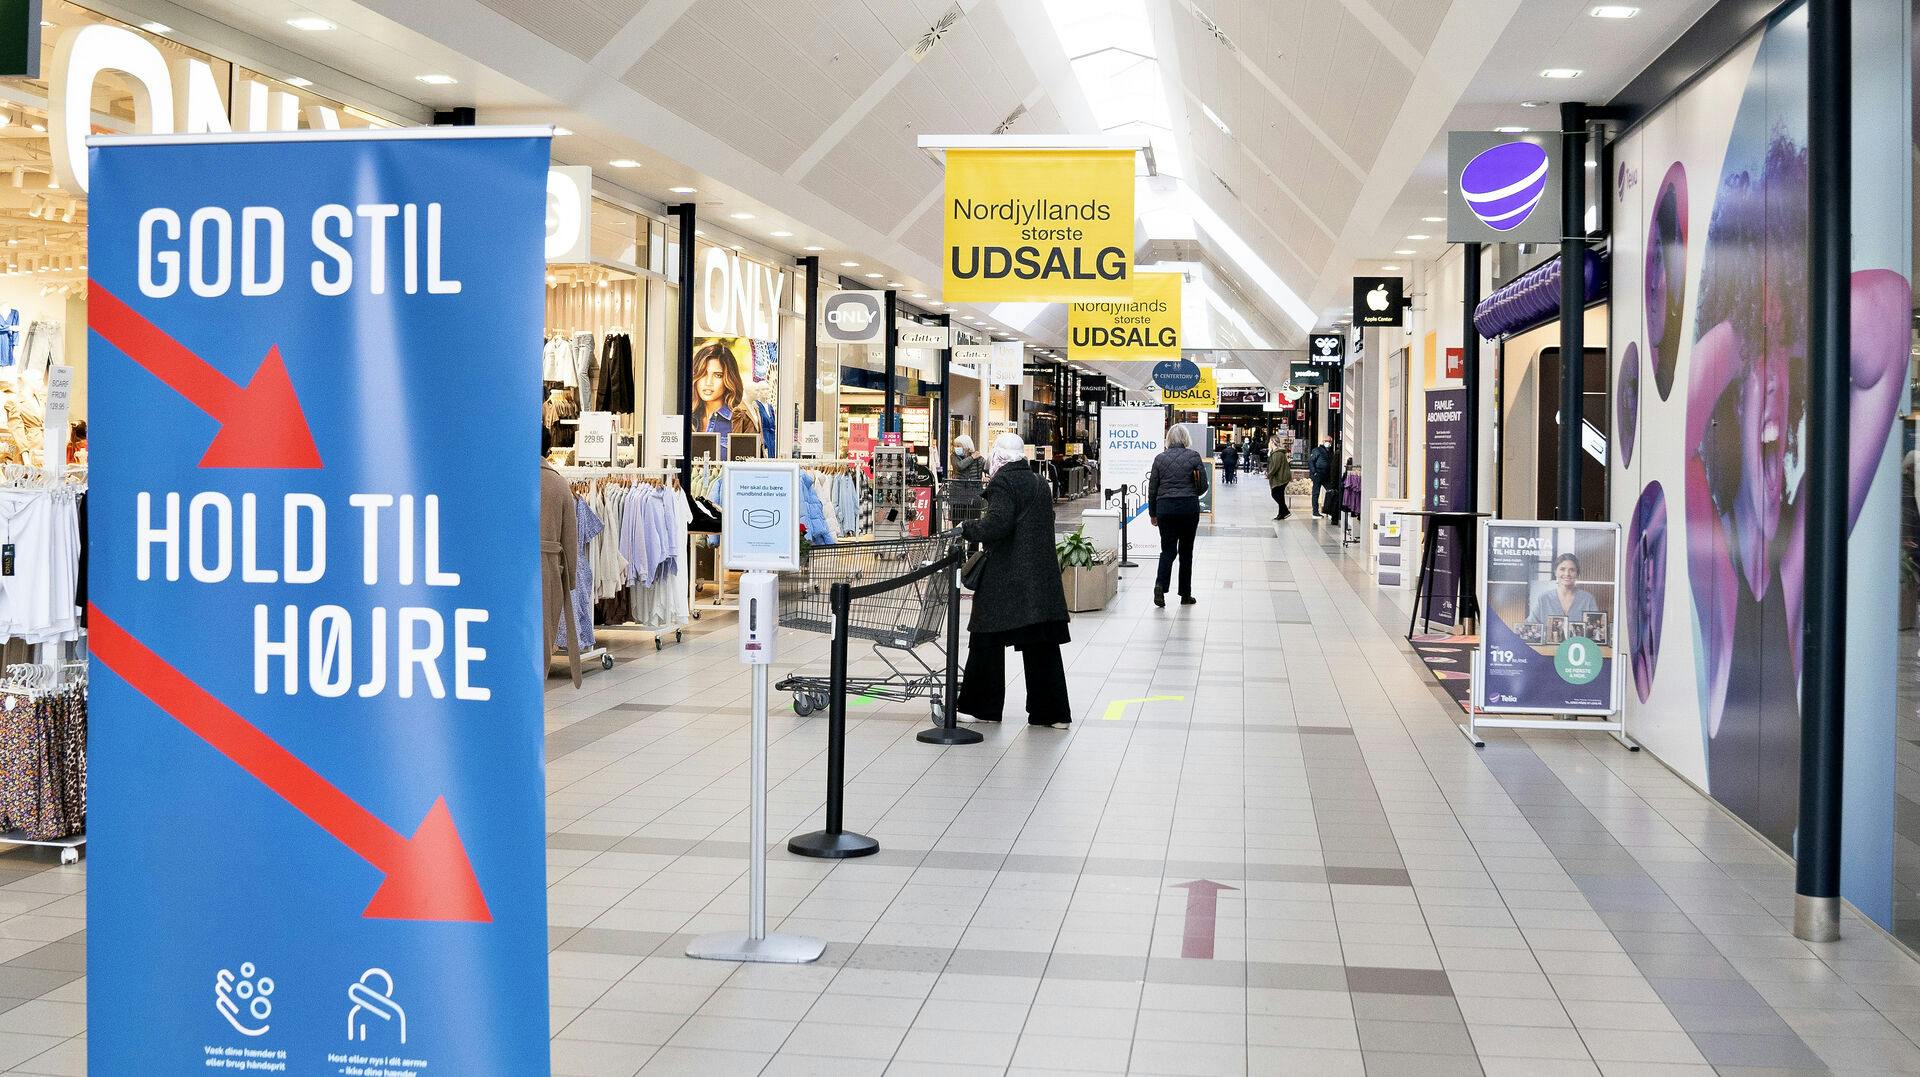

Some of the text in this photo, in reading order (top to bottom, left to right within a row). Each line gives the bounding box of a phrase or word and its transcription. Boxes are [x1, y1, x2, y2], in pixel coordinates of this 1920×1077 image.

[954, 198, 1111, 226] Nordjyllands
[1021, 226, 1083, 241] største
[138, 206, 285, 298] GOD
[311, 202, 462, 297] STIL
[951, 246, 1127, 281] UDSALG
[700, 247, 785, 340] ONLY
[827, 310, 878, 324] ONLY
[1114, 315, 1151, 325] største
[1073, 327, 1177, 348] UDSALG
[51, 391, 67, 399] FROM
[1163, 389, 1211, 399] UDSALG
[584, 435, 604, 443] 229.95
[660, 435, 679, 443] 229.95
[1109, 429, 1139, 438] HOLD
[1109, 440, 1157, 450] AFSTAND
[137, 491, 461, 587] HOLD TIL
[1493, 536, 1554, 550] FRI DATA
[254, 604, 492, 701] HØJRE
[1490, 650, 1513, 663] 119
[1567, 643, 1586, 667] 0
[1500, 694, 1517, 703] Telia
[204, 1045, 287, 1059] Vask dine hænder tit
[205, 1057, 286, 1071] eller brug håndsprit
[328, 1053, 348, 1063] Host
[348, 1054, 369, 1064] eller
[369, 1057, 384, 1067] nys
[389, 1056, 401, 1066] dit
[402, 1059, 428, 1068] ærme
[345, 1066, 363, 1075] ikke
[364, 1067, 383, 1077] dine
